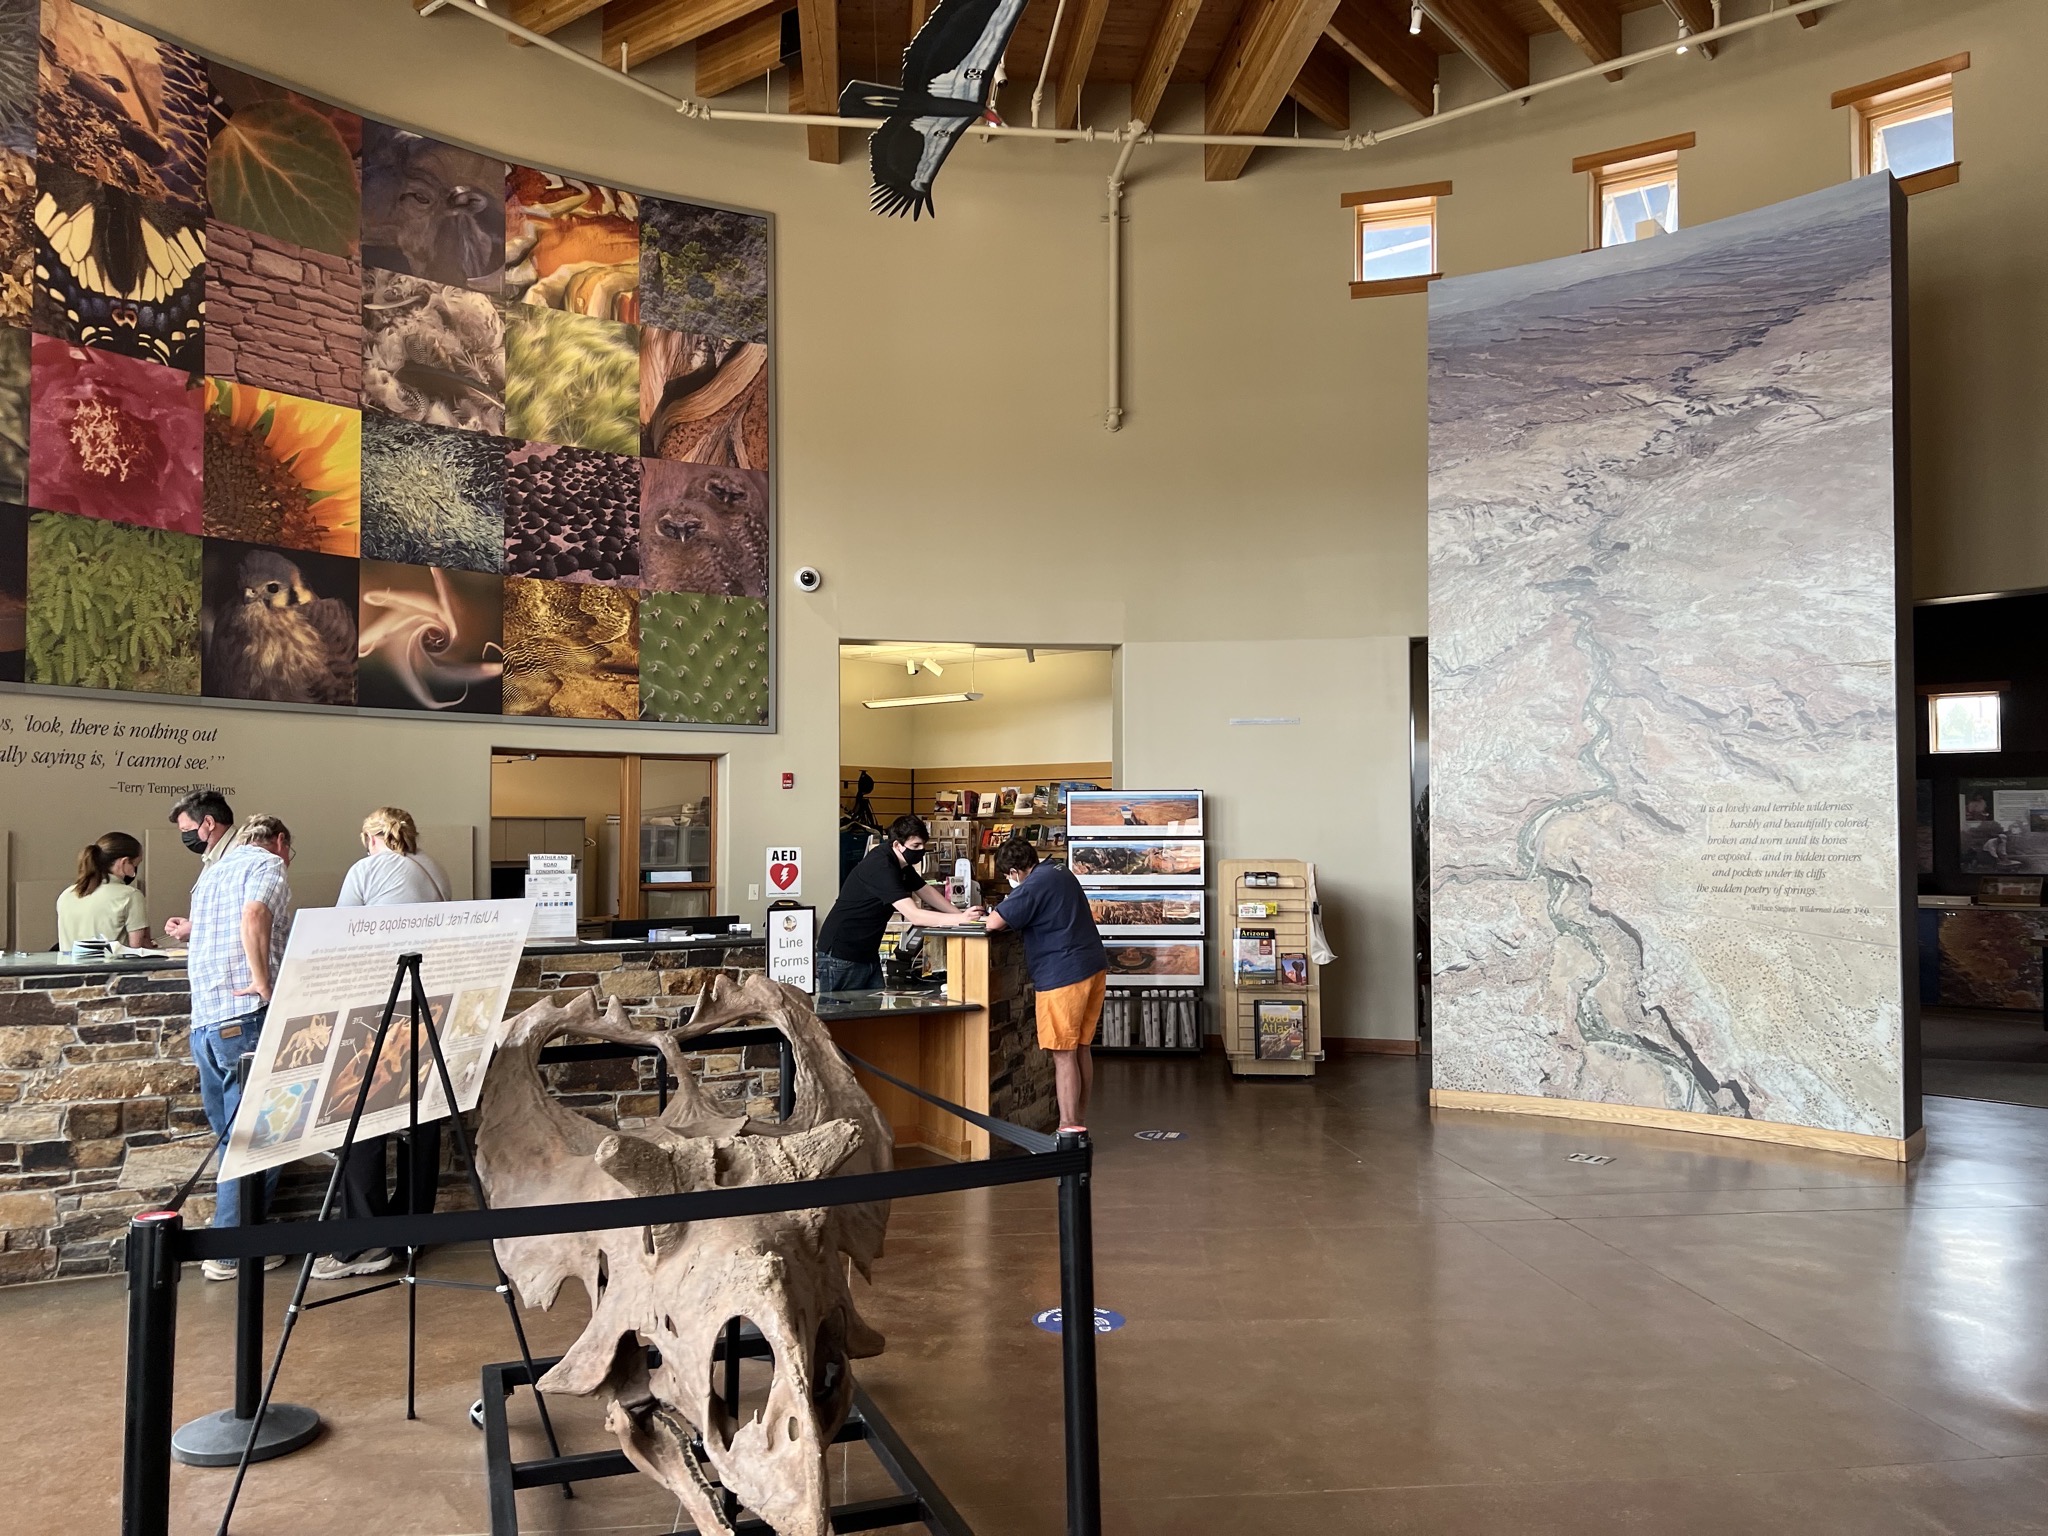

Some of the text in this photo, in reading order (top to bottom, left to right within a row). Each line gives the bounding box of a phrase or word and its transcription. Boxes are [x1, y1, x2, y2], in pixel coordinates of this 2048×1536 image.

[70, 718, 109, 736] there
[113, 721, 126, 737] is
[129, 722, 189, 744] nothing
[192, 728, 218, 742] out
[31, 749, 86, 770] saying
[90, 750, 105, 769] is,
[127, 754, 182, 769] cannot
[148, 782, 189, 797] Tempest
[1709, 804, 1715, 813] is
[1717, 805, 1723, 813] a
[1725, 803, 1750, 814] lovely
[1752, 802, 1771, 812] and
[1772, 802, 1805, 812] terrible
[1807, 801, 1854, 811] wilderness
[1763, 819, 1783, 829] and
[1784, 818, 1832, 831] beautifully
[1707, 835, 1848, 845] broken and worn until its bones
[772, 850, 797, 861] AED
[1701, 853, 1716, 861] are
[1783, 852, 1792, 861] in
[1795, 851, 1826, 861] hidden
[1712, 867, 1827, 880] and pockets under its cliffs
[1696, 884, 1709, 892] the
[1710, 883, 1742, 893] sudden
[1743, 885, 1771, 896] poetry
[1773, 884, 1784, 896] of
[779, 938, 803, 949] Line
[773, 956, 809, 968] Forms
[778, 975, 806, 984] Here
[1262, 1012, 1289, 1023] Road
[1261, 1023, 1290, 1034] Atlas
